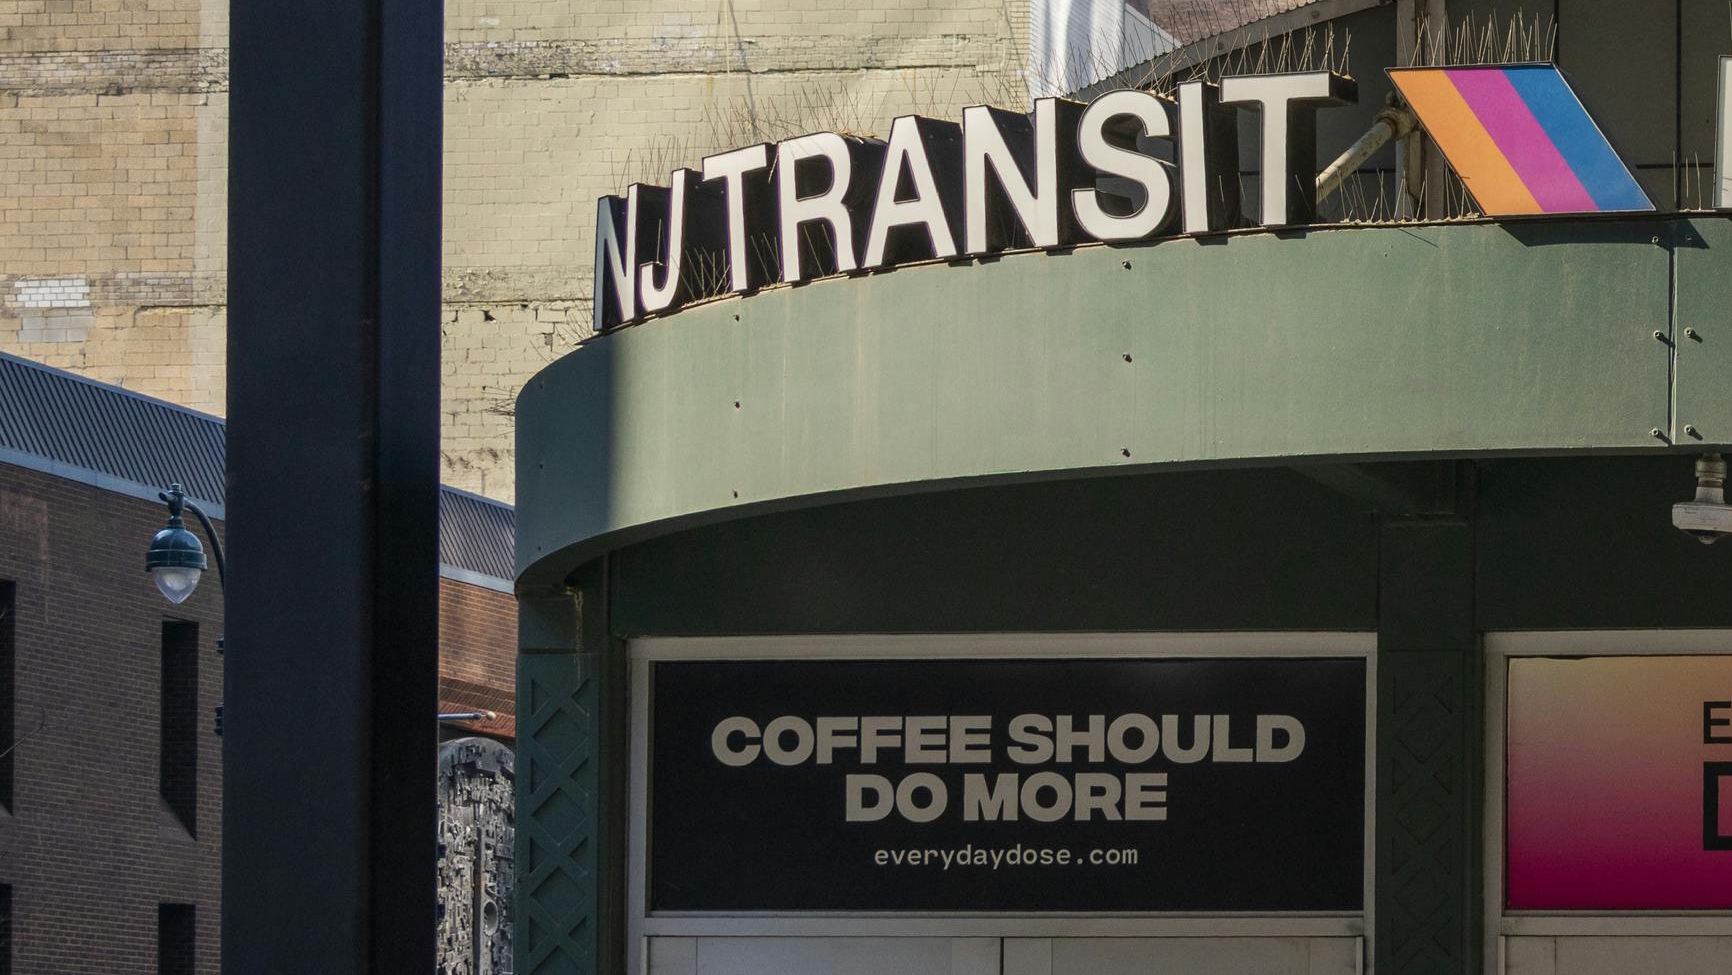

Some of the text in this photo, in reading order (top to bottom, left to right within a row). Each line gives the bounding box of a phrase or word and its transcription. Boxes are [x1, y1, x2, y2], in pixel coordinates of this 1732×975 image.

[593, 168, 686, 331] NJ
[701, 70, 1332, 292] TRANSIT
[711, 714, 1306, 766] COFFEE SHOULD
[845, 772, 1168, 822] DO MORE
[873, 844, 1139, 871] everydaydose.com
